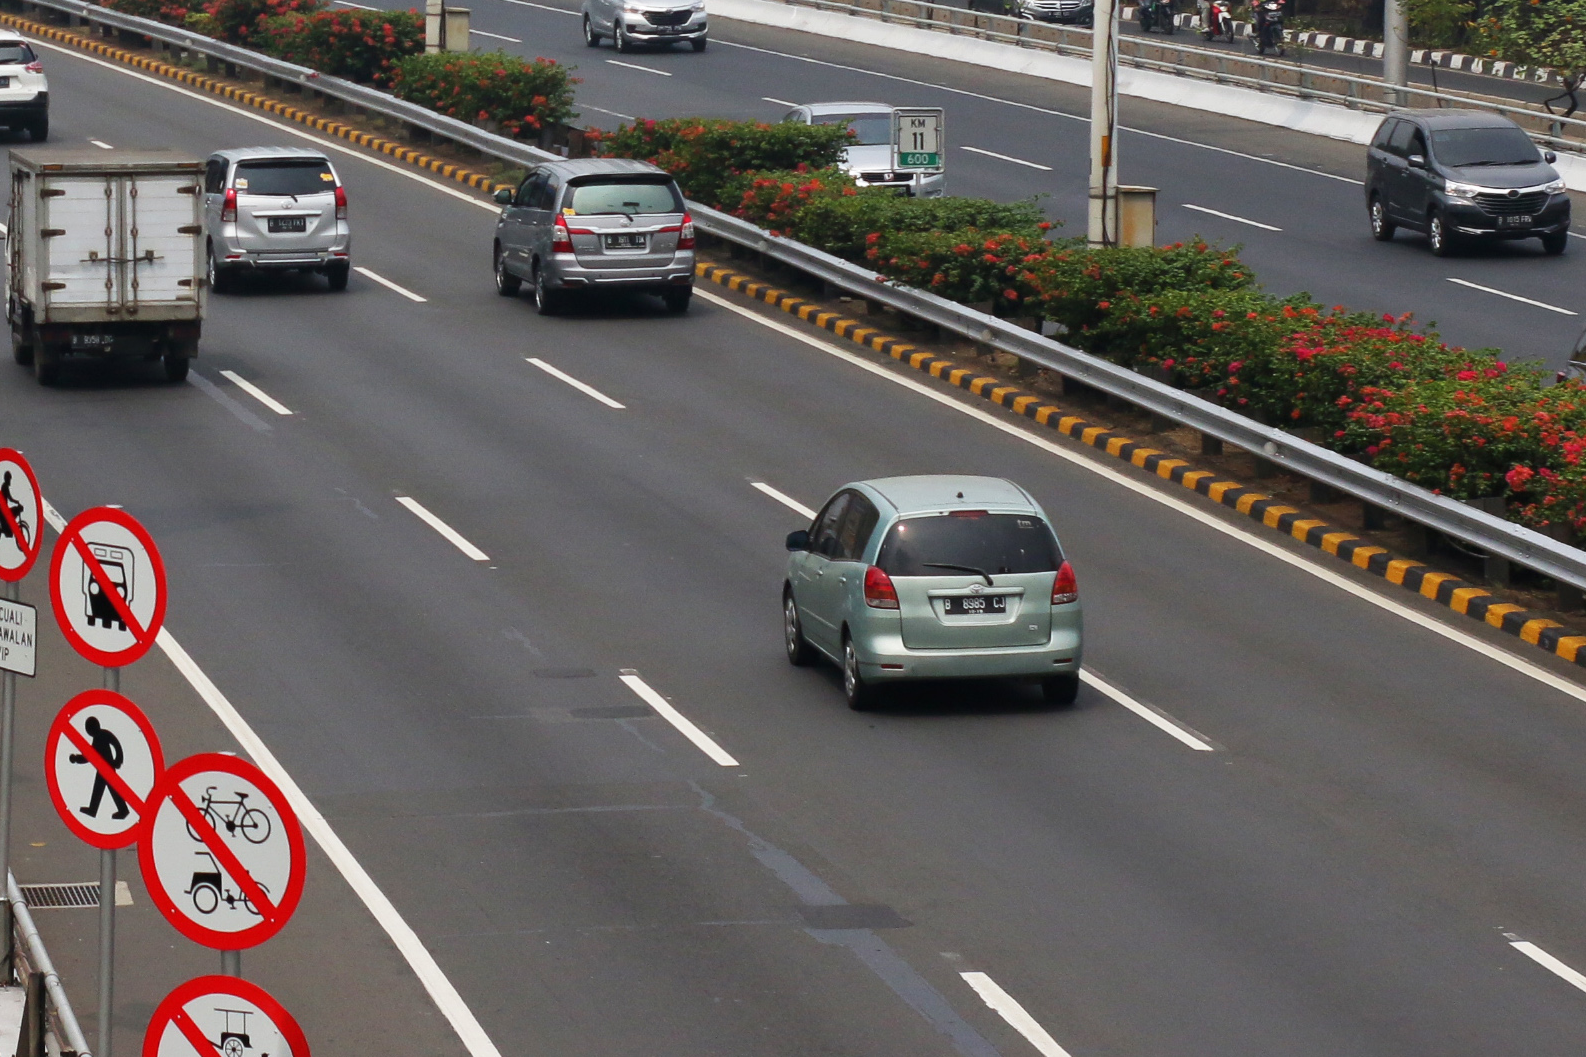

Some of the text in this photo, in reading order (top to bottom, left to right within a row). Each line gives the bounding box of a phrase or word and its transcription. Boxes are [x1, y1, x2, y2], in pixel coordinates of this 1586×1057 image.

[910, 118, 926, 129] KM
[912, 131, 924, 151] 11
[907, 154, 929, 164] 600
[944, 596, 1005, 610] B 8985 CJ
